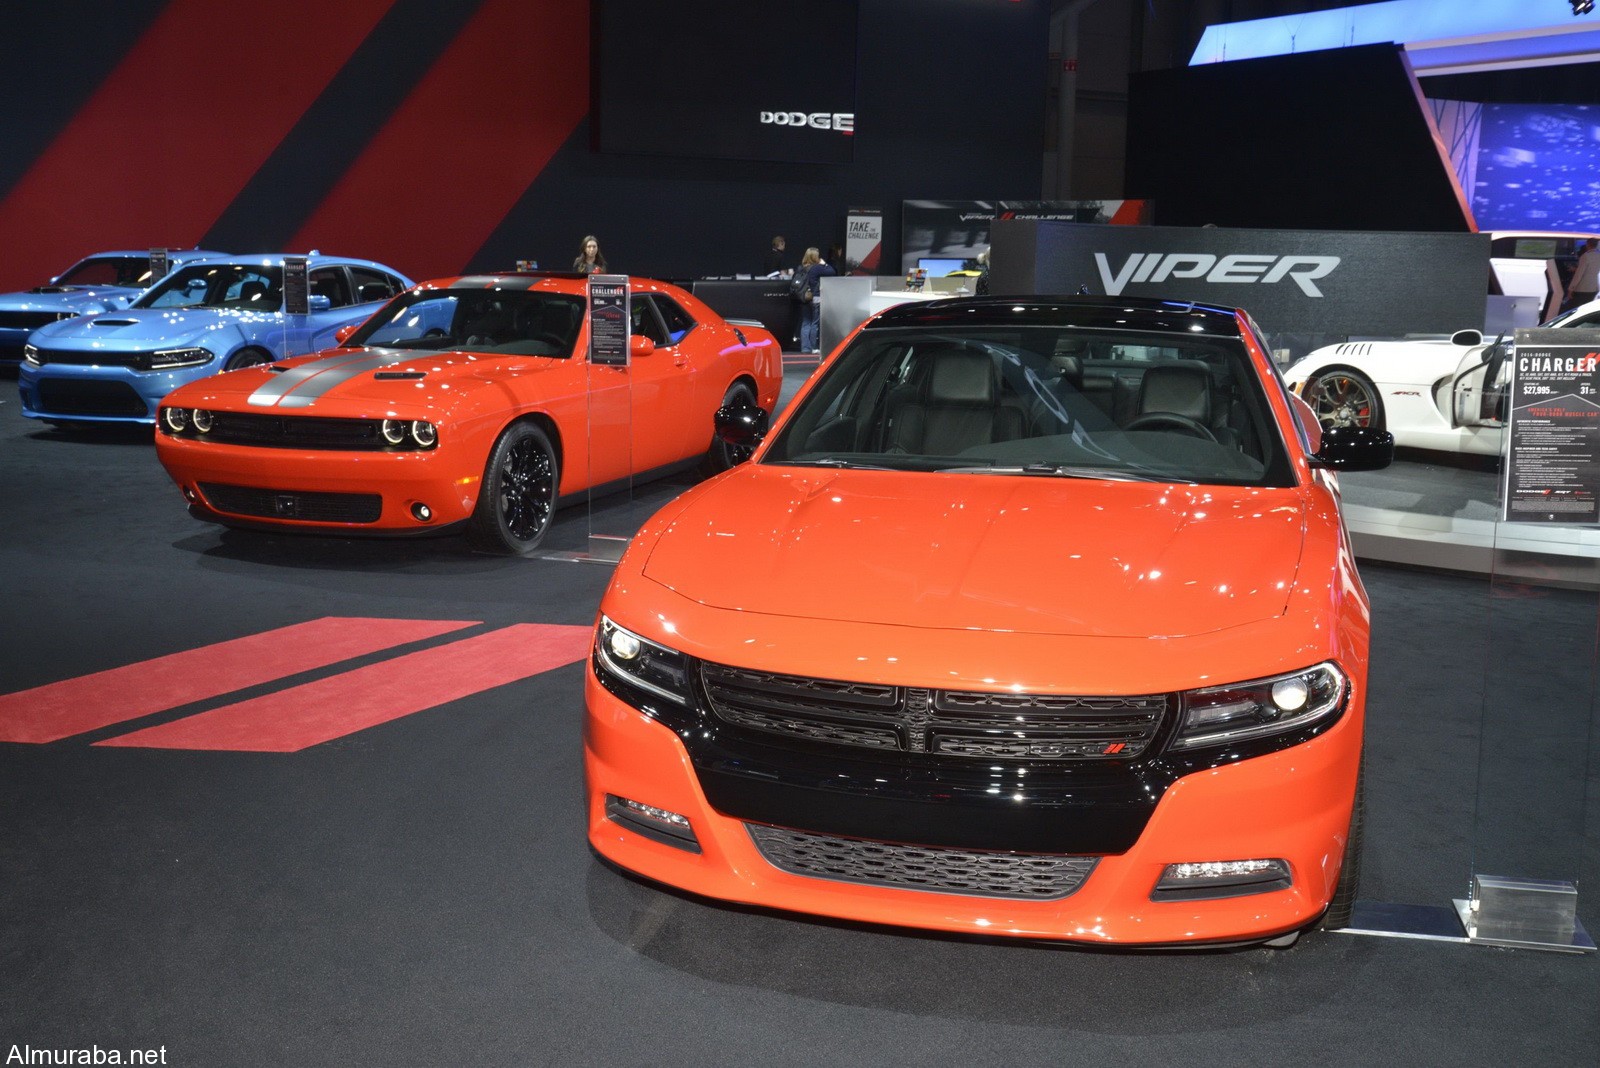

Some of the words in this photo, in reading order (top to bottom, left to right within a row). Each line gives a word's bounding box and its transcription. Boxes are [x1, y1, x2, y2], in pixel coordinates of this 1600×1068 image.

[760, 111, 854, 131] DODGE
[849, 221, 871, 232] TAKE
[1094, 252, 1342, 298] VIPER
[1519, 357, 1597, 372] CHARGER
[1523, 386, 1551, 395] $27,995
[1580, 386, 1589, 394] 31
